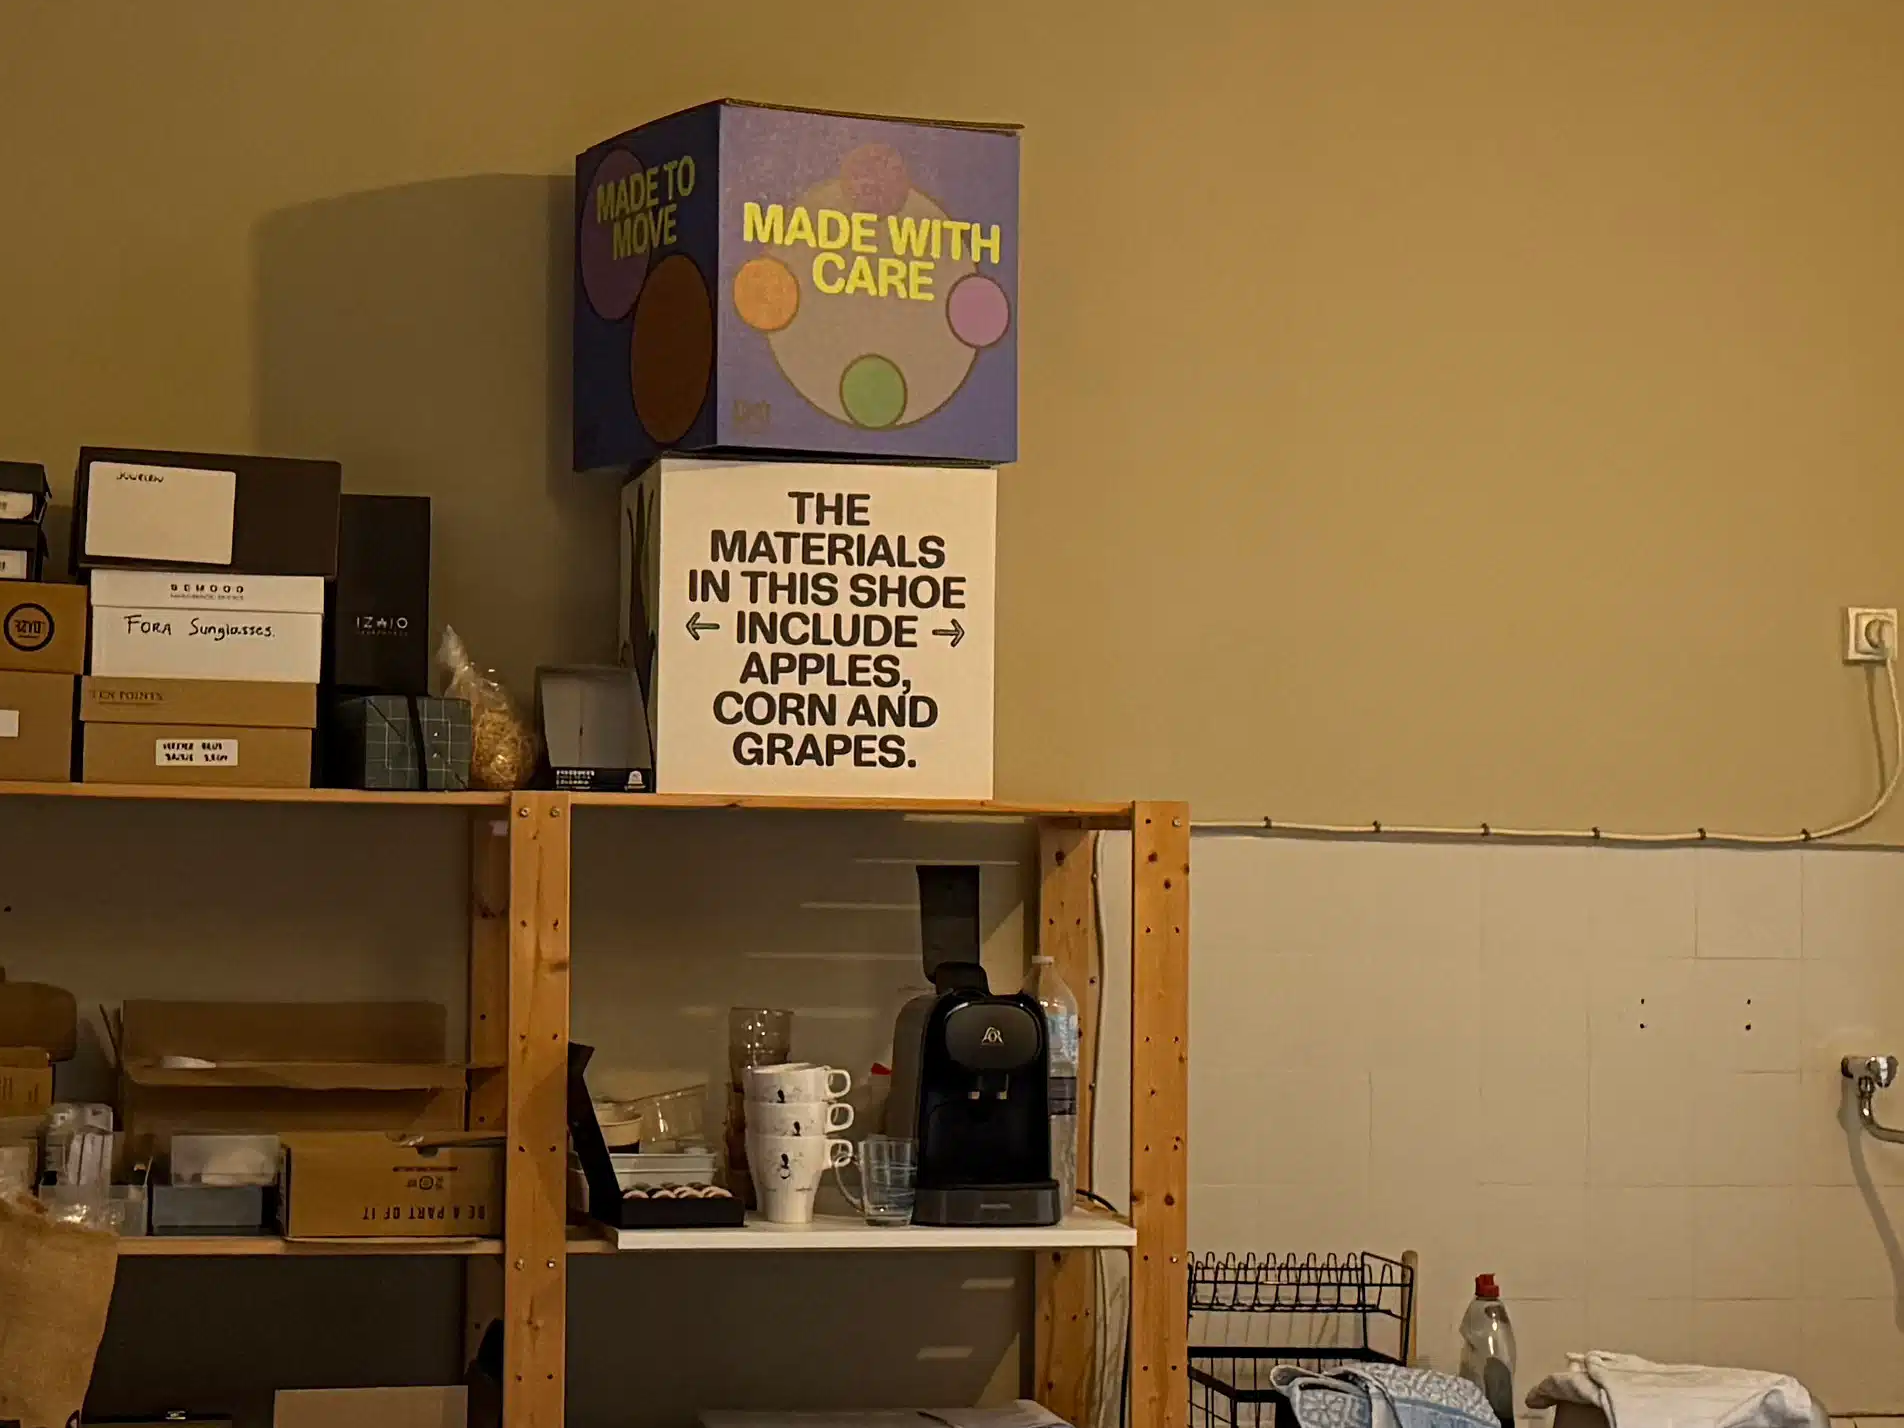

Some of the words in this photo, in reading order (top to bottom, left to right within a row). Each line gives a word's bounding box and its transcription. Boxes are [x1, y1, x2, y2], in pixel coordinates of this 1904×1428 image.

[597, 166, 659, 223] MADE
[663, 155, 696, 200] TO
[613, 203, 677, 260] MOVE
[743, 202, 878, 253] MADE
[887, 215, 1000, 264] WITH
[812, 251, 935, 301] CARE
[788, 491, 870, 526] THE
[710, 529, 945, 569] MATERIALS
[688, 569, 730, 602] IN
[740, 570, 839, 606] THIS
[850, 573, 966, 609] SHOE
[124, 614, 172, 636] FORA
[736, 610, 918, 647] INCLUDE
[739, 651, 911, 694] APPLES,
[713, 690, 837, 726] CORN
[847, 694, 938, 727] AND
[732, 731, 917, 768] GRAPES.
